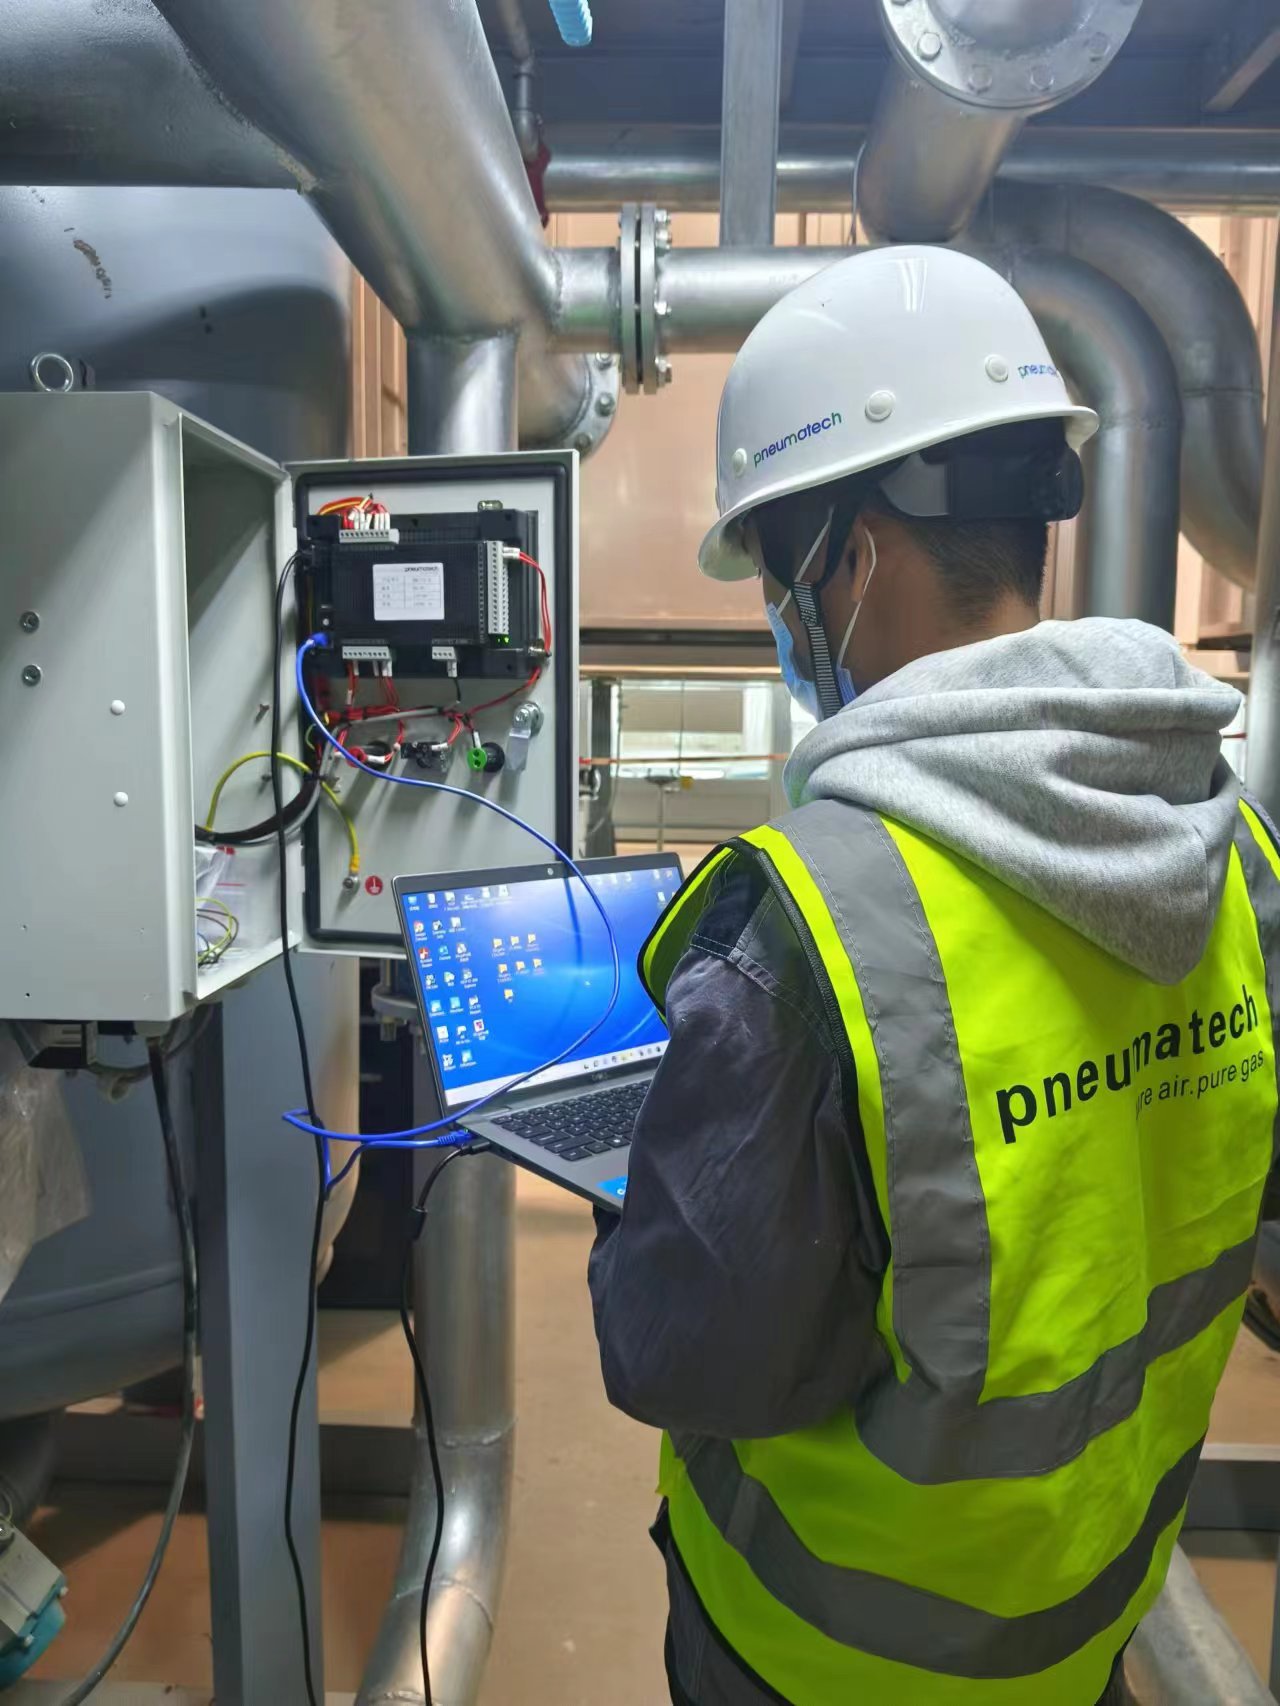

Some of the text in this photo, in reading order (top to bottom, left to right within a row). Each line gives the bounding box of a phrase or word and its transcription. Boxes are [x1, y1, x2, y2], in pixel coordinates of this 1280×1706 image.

[753, 412, 842, 468] pneumatech
[996, 984, 1258, 1144] pneumatech
[1197, 1064, 1237, 1100] pure
[1241, 1050, 1264, 1082] gas
